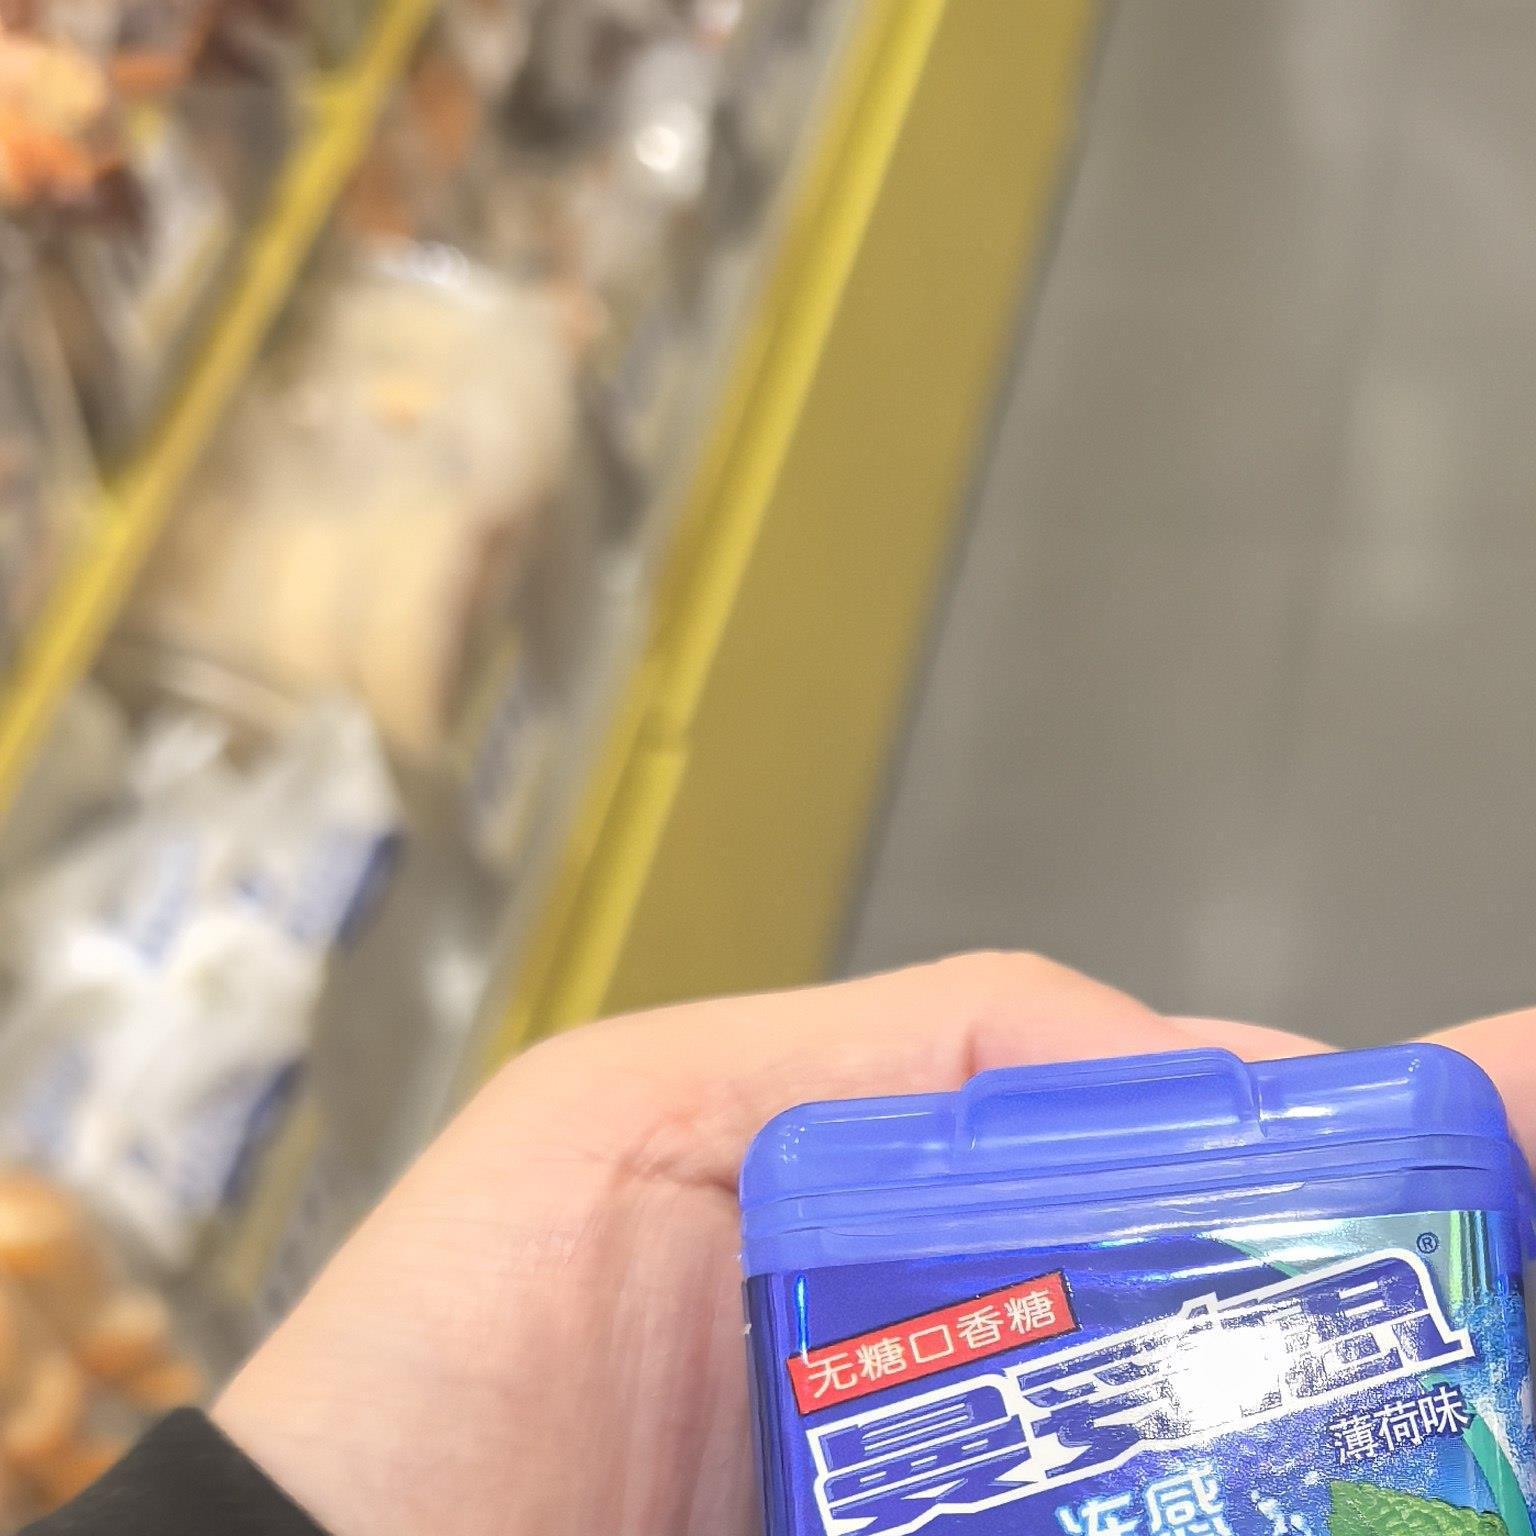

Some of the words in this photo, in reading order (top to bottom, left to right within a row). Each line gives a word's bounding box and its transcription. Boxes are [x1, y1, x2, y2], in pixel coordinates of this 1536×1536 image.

[808, 1287, 1057, 1398] 无糖口香糖
[1329, 1386, 1470, 1464] 薄荷味
